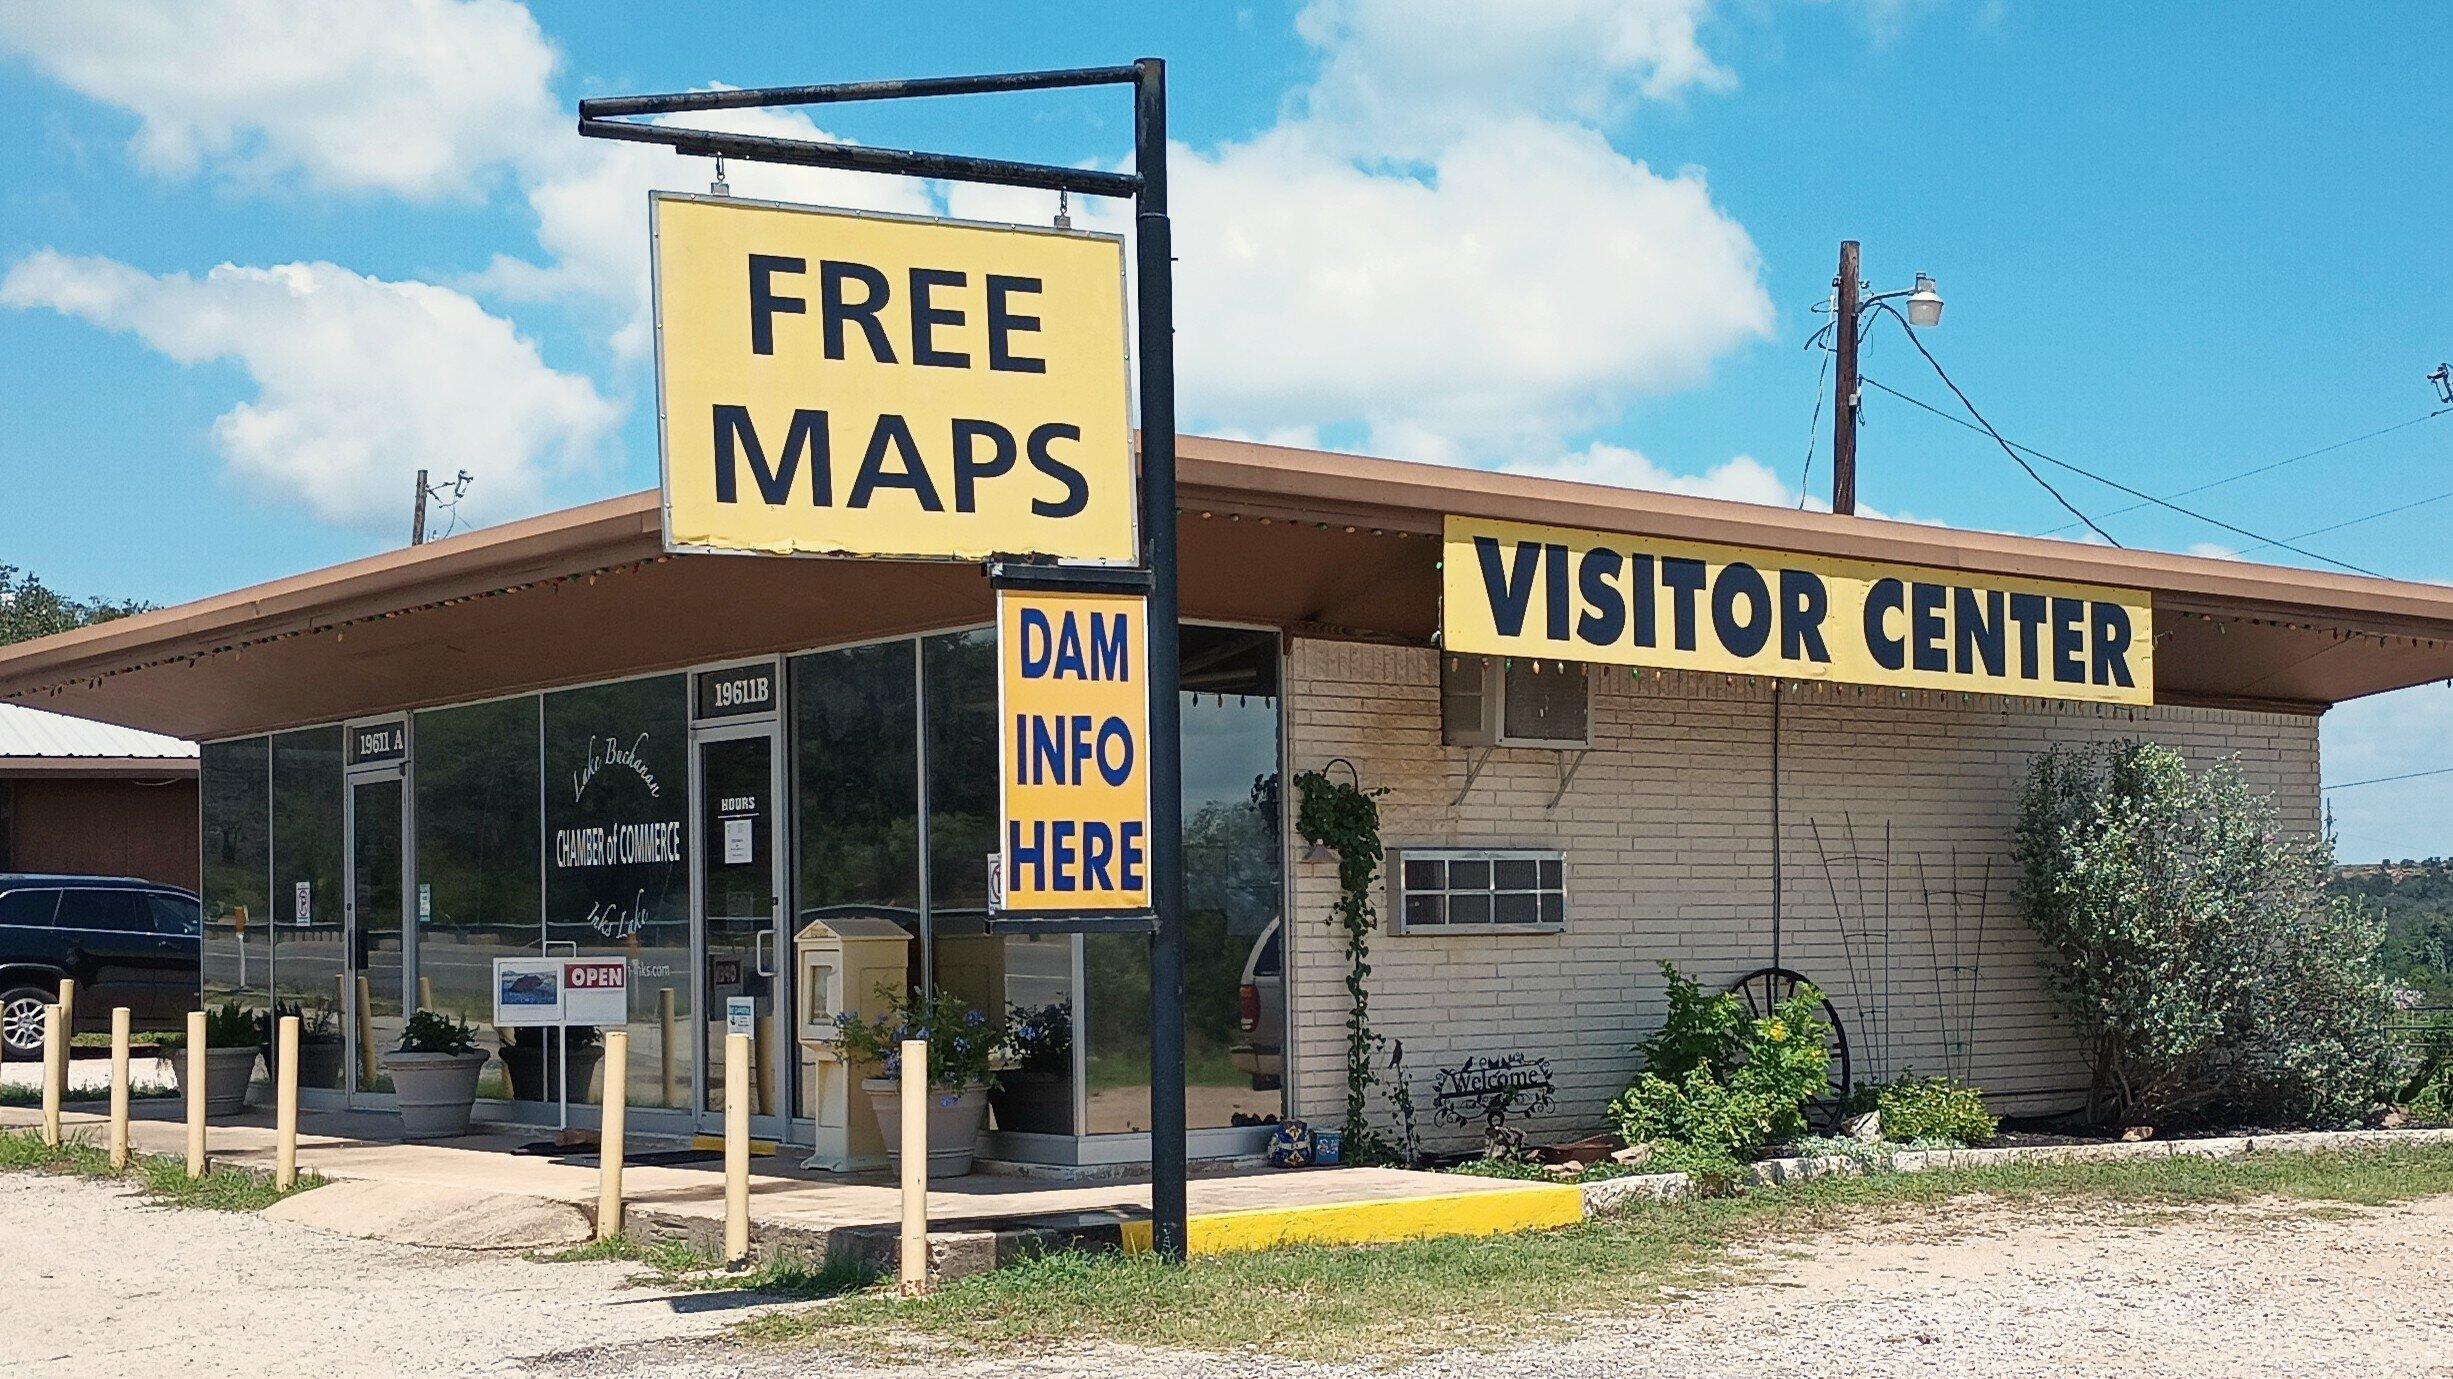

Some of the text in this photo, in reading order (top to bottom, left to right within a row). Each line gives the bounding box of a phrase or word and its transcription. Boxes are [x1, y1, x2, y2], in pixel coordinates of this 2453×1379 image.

[748, 253, 1046, 374] FREE
[712, 404, 1090, 518] MAPS
[1473, 535, 2135, 689] VISITOR CENTER
[1020, 607, 1129, 682] DAM
[715, 677, 769, 707] 19611B
[360, 729, 404, 755] 19611 A
[573, 732, 660, 802] Lake Buchanan
[1016, 714, 1134, 787] INFO
[721, 796, 756, 812] HOURS
[556, 827, 604, 868] CHAMBER
[606, 822, 618, 866] of
[619, 821, 681, 865] COMMERCE
[1009, 820, 1144, 892] HERE
[587, 888, 649, 939] Inks Lake
[571, 967, 623, 987] OPEN
[1440, 1066, 1540, 1095] Welcome
